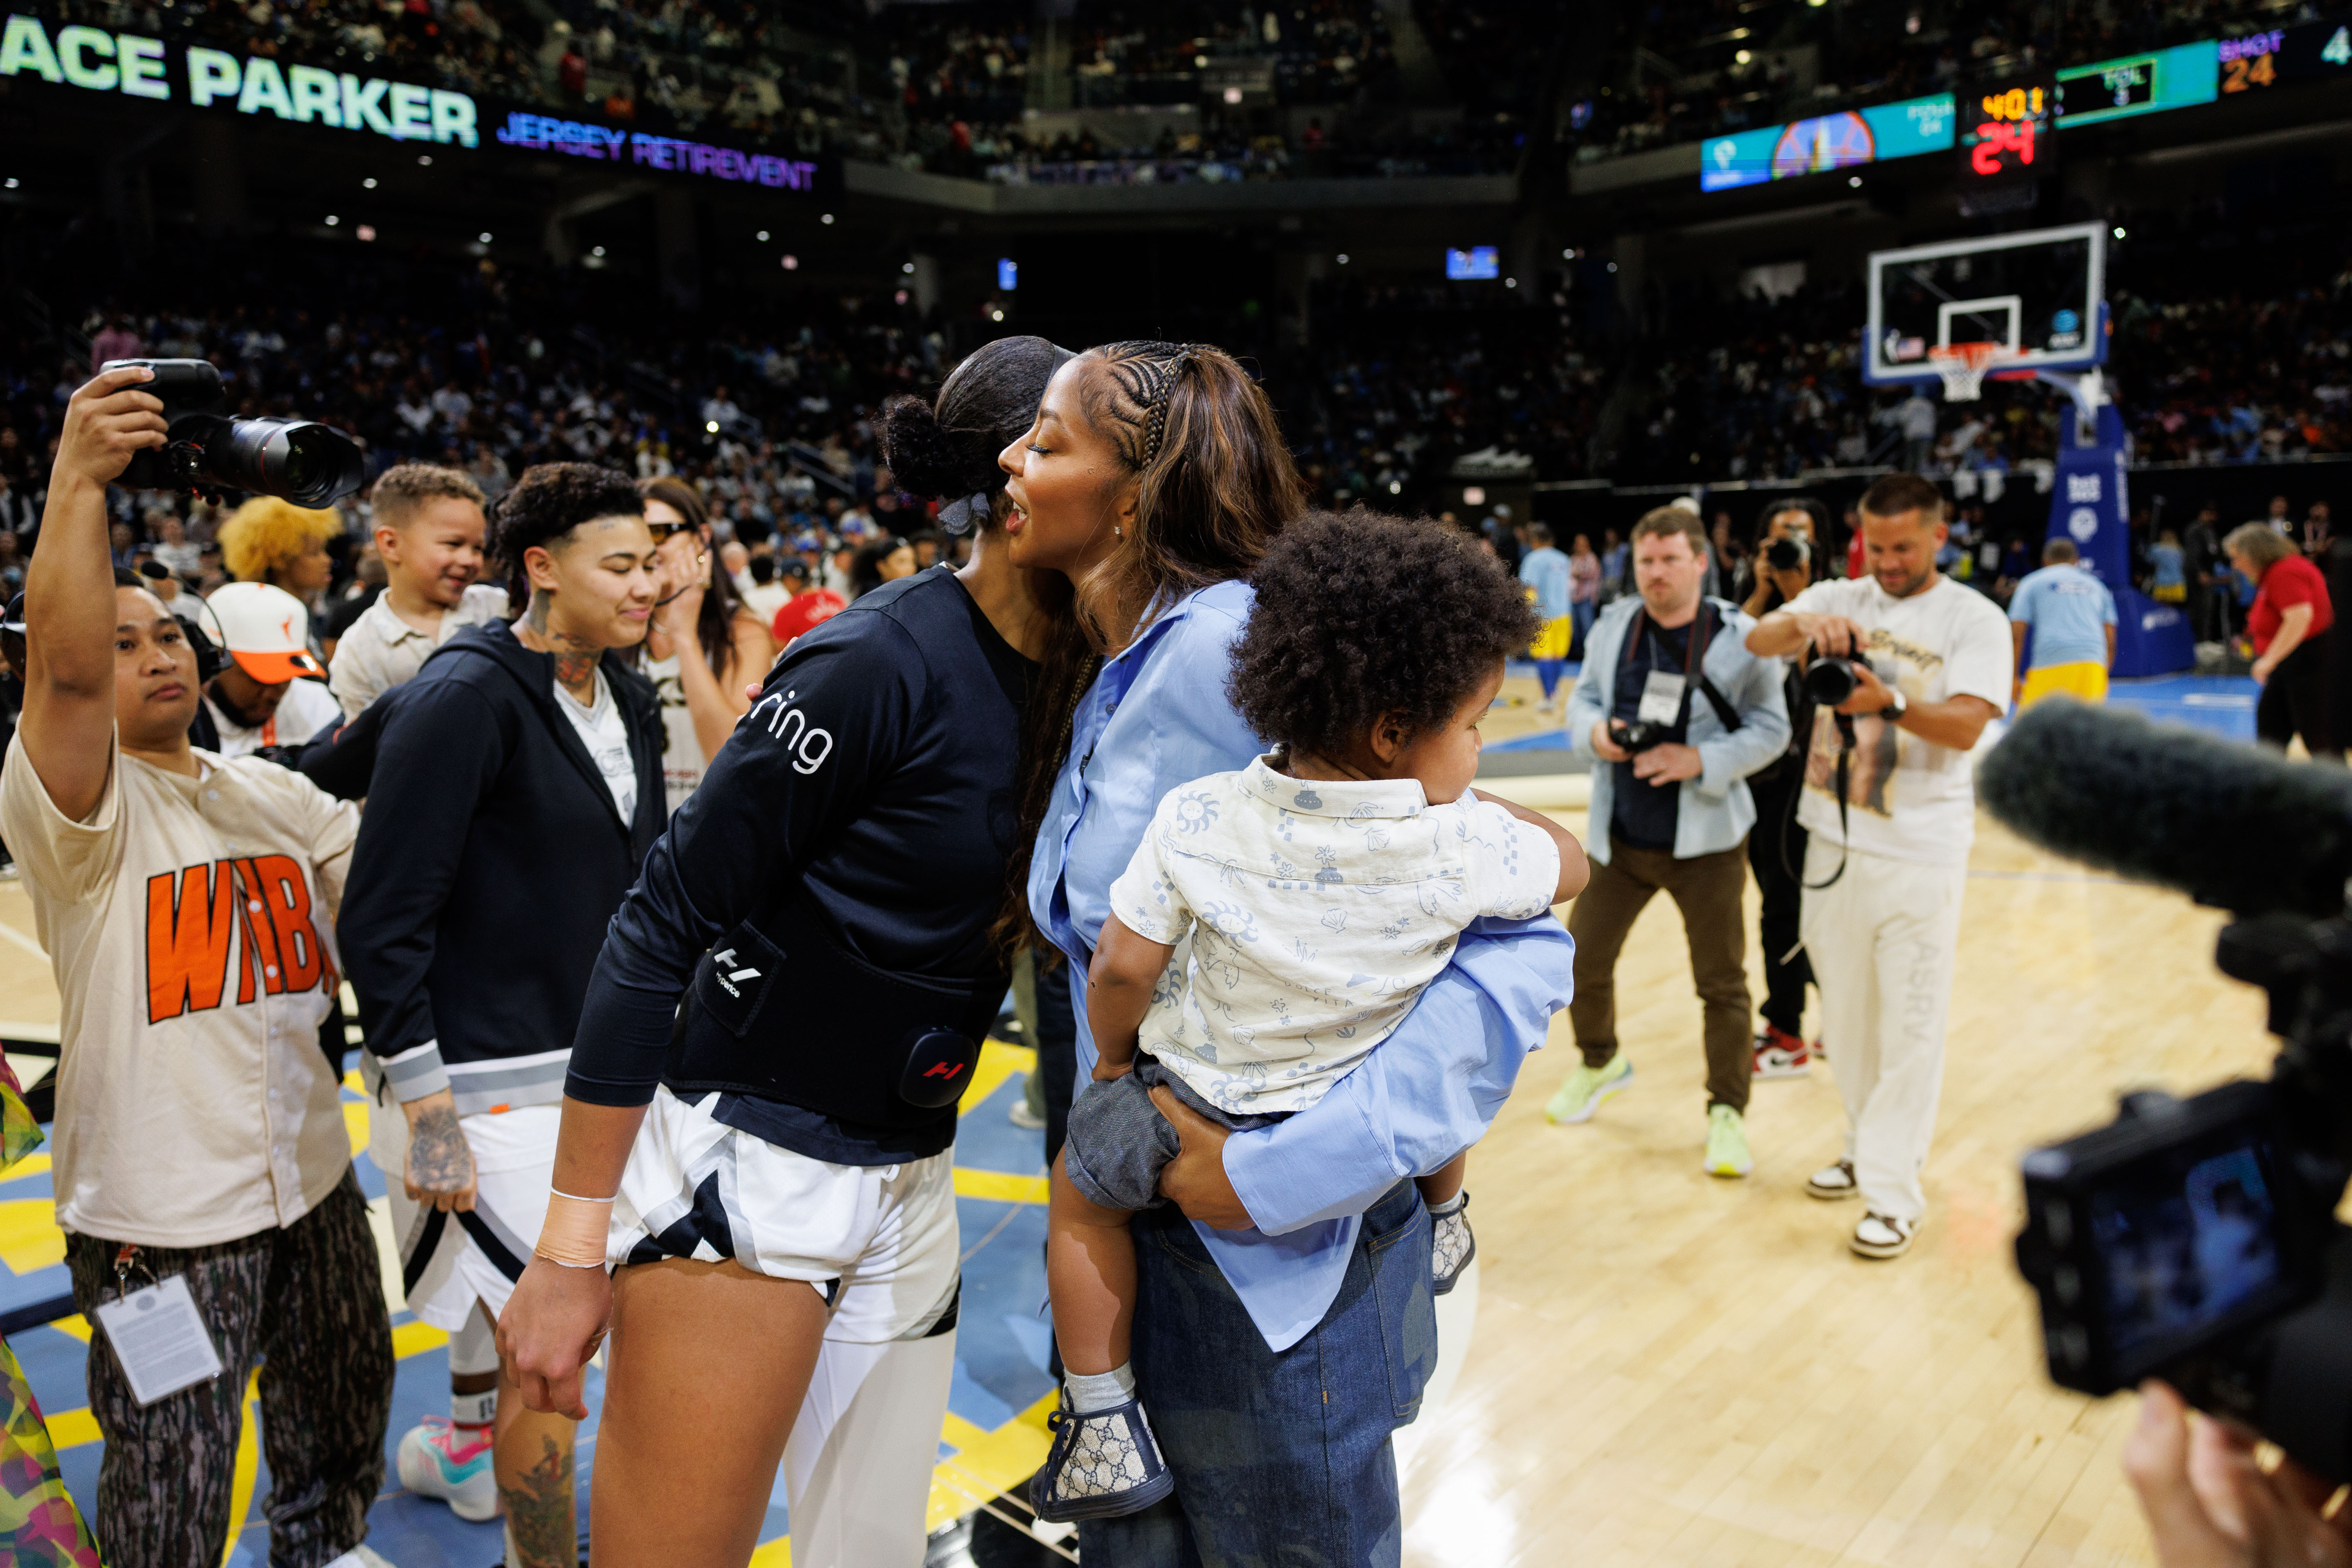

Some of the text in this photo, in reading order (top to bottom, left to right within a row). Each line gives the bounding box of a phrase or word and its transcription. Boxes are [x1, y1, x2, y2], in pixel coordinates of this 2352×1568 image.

[2218, 29, 2286, 63] SHOT
[2222, 50, 2277, 94] 24
[0, 13, 480, 149] ACE PARKER
[496, 111, 818, 191] JERSEY RETIREMENT
[1972, 119, 2035, 175] 24
[750, 690, 833, 774] ring
[1284, 981, 1332, 996] DOLCE
